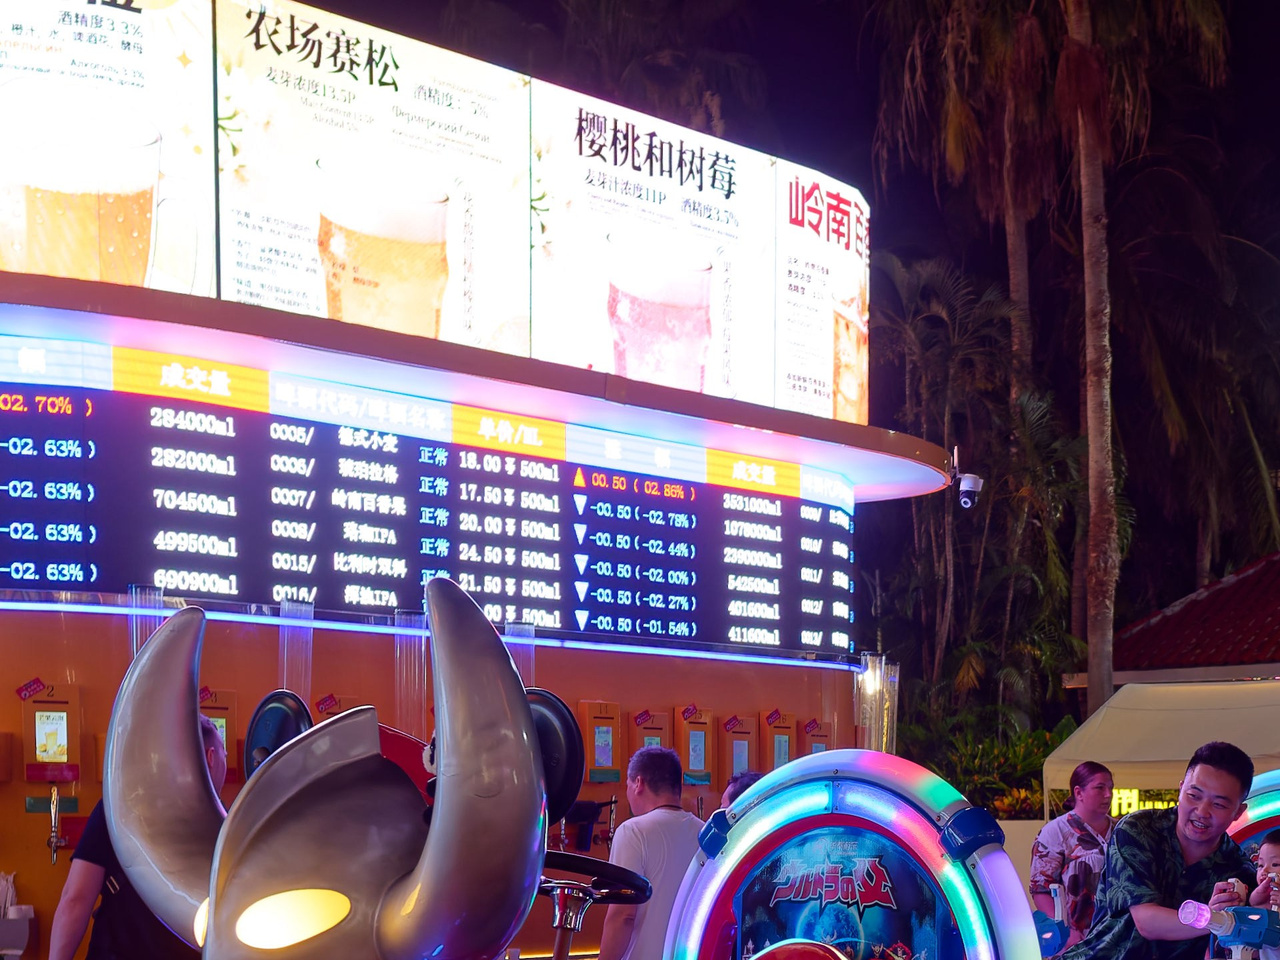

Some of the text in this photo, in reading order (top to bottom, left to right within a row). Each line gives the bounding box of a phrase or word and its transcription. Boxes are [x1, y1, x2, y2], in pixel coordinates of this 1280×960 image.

[243, 3, 400, 92] 农场赛松
[573, 106, 738, 200] 樱桃和树莓
[583, 167, 667, 205] 麦芽汁浓度11P
[150, 407, 236, 437] 284000ml
[159, 362, 232, 397] 成交量
[732, 460, 776, 487] 成交量
[151, 447, 237, 476] 282000ml
[418, 446, 449, 467] 正常
[520, 459, 561, 483] 500ml
[418, 475, 450, 497] 正常
[520, 490, 561, 514] 500ml
[331, 487, 407, 517] 岭南百香果
[419, 507, 450, 528] 正常
[521, 519, 561, 542] 500ml
[420, 538, 450, 558] 正常
[521, 550, 562, 571] 500ml
[521, 579, 562, 600] 500ml
[46, 685, 55, 697] 2
[769, 856, 899, 913] ウルトラの父
